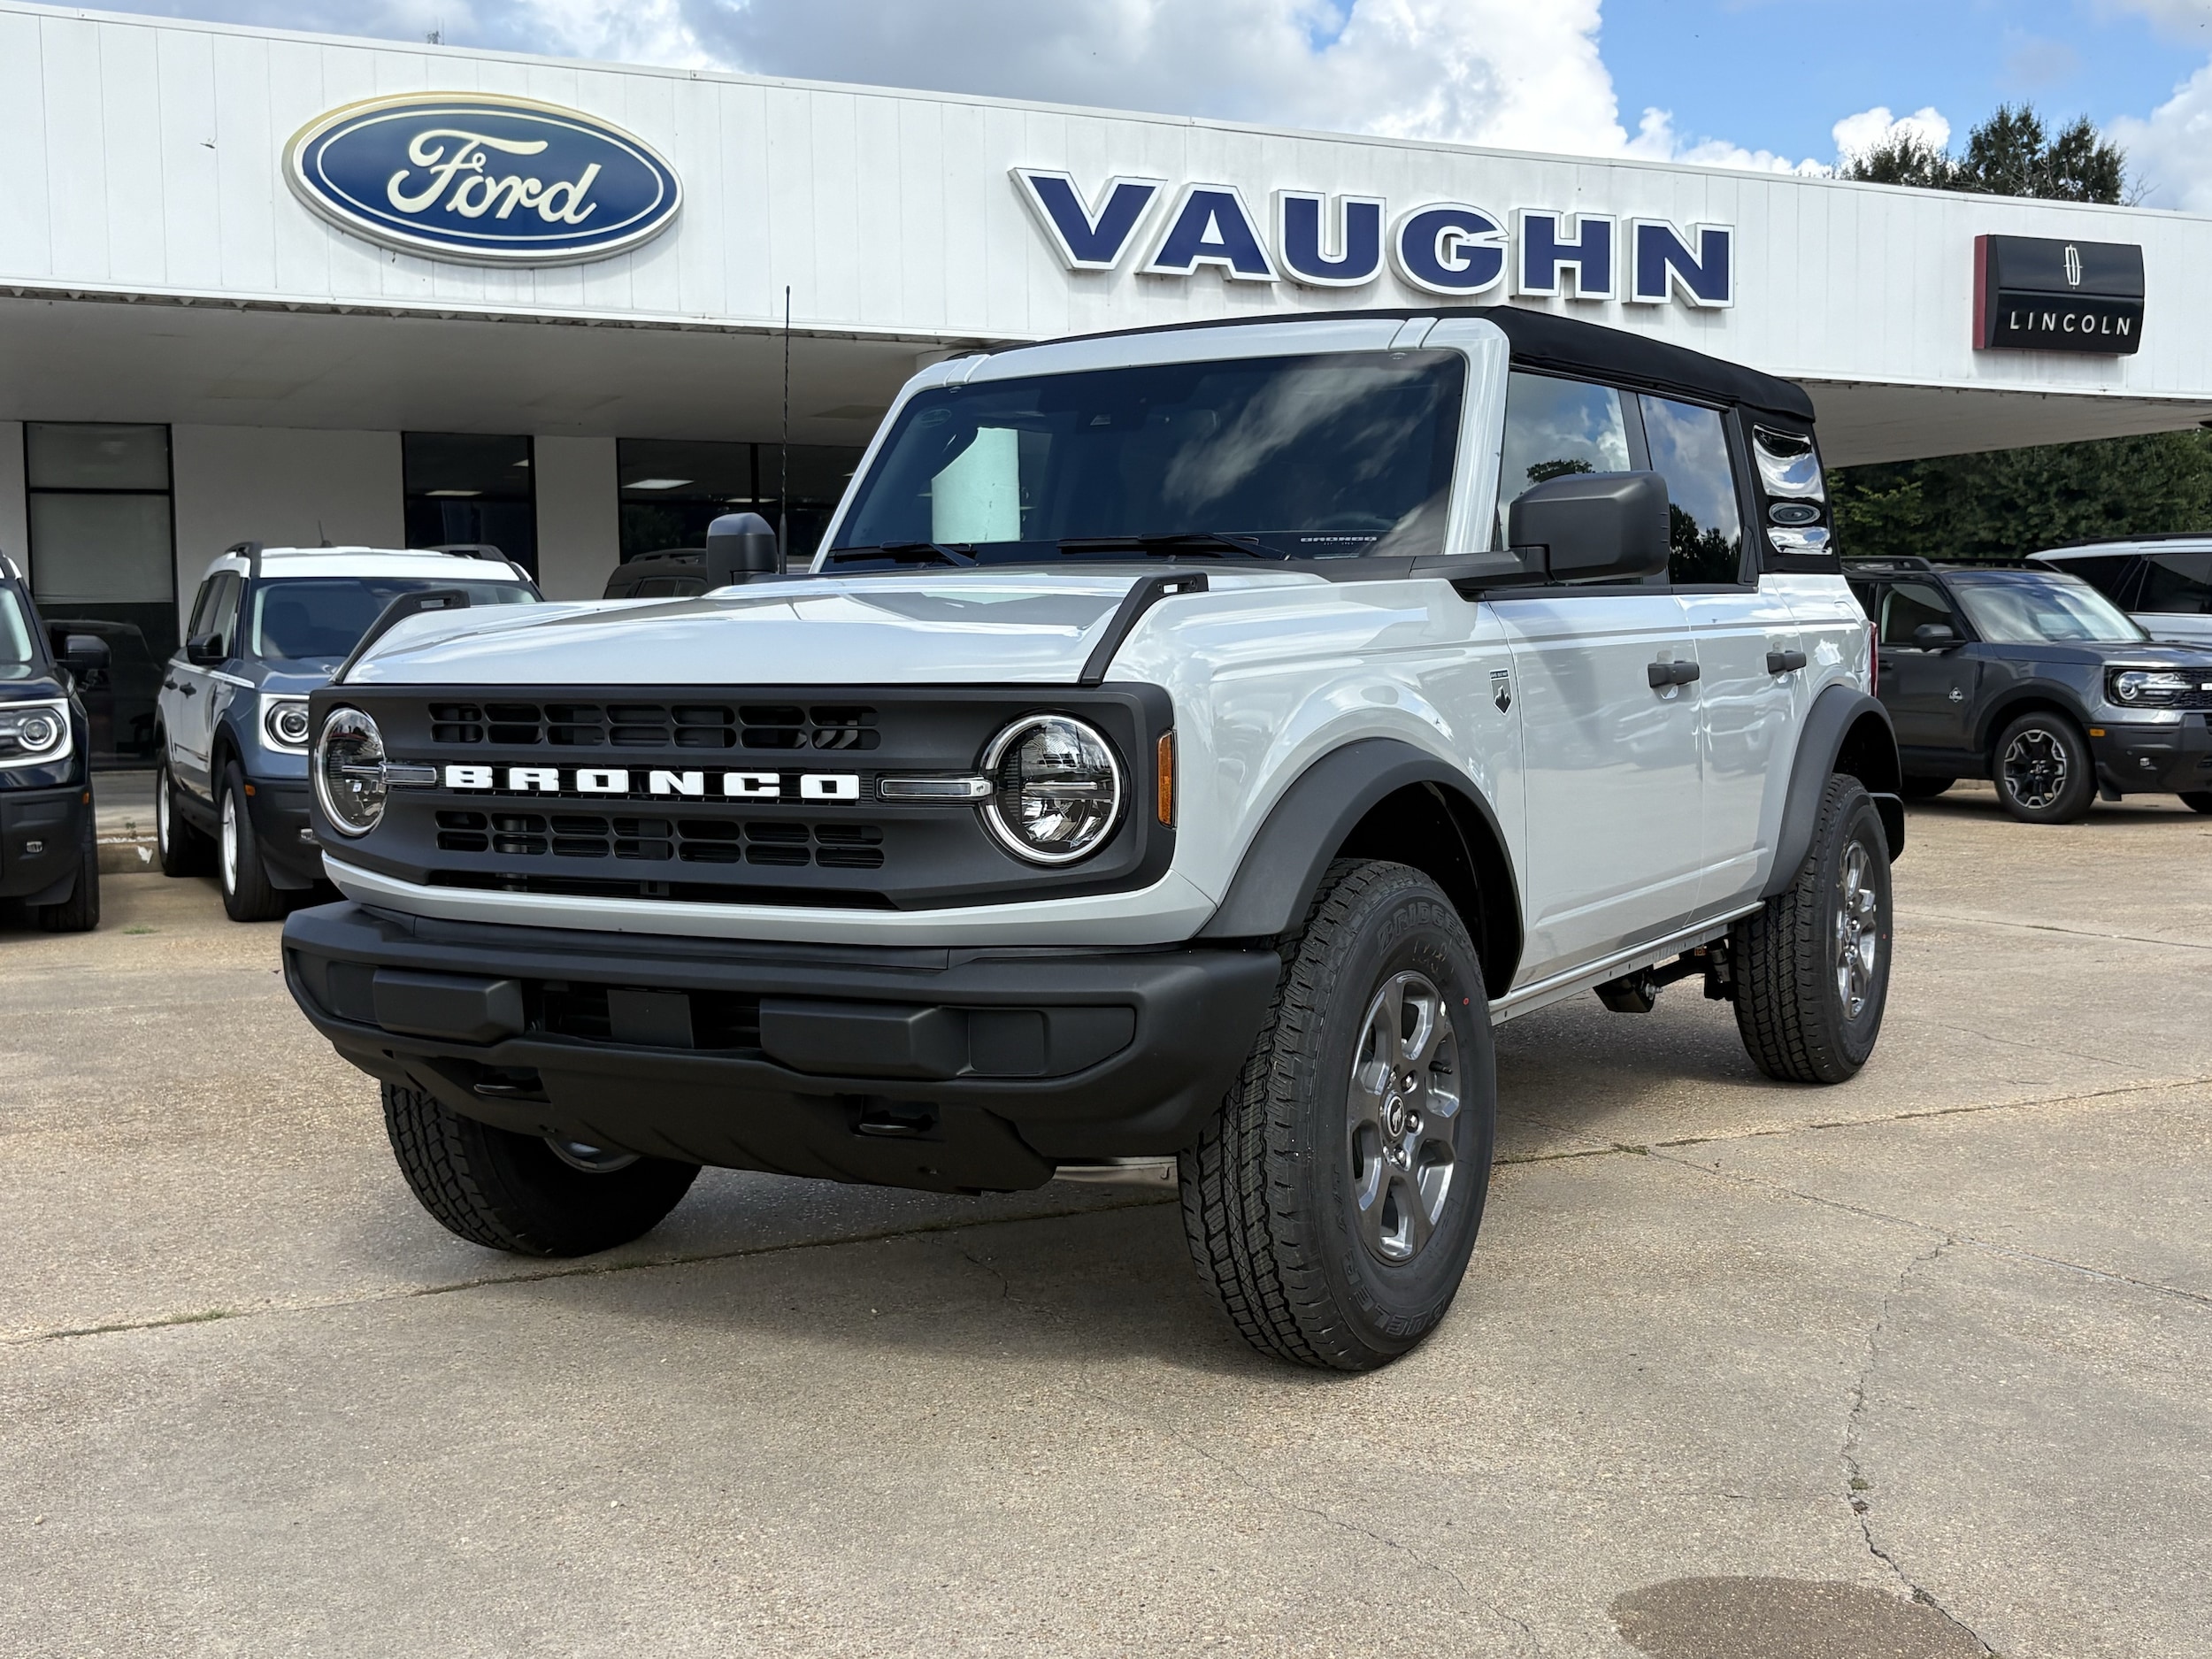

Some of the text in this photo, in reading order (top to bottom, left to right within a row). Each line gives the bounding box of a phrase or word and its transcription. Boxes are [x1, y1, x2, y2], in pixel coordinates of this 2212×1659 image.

[388, 129, 602, 224] Ford
[1009, 168, 1735, 309] VAUGHN
[2010, 311, 2130, 335] LINCOLN
[445, 764, 860, 799] BRONCO
